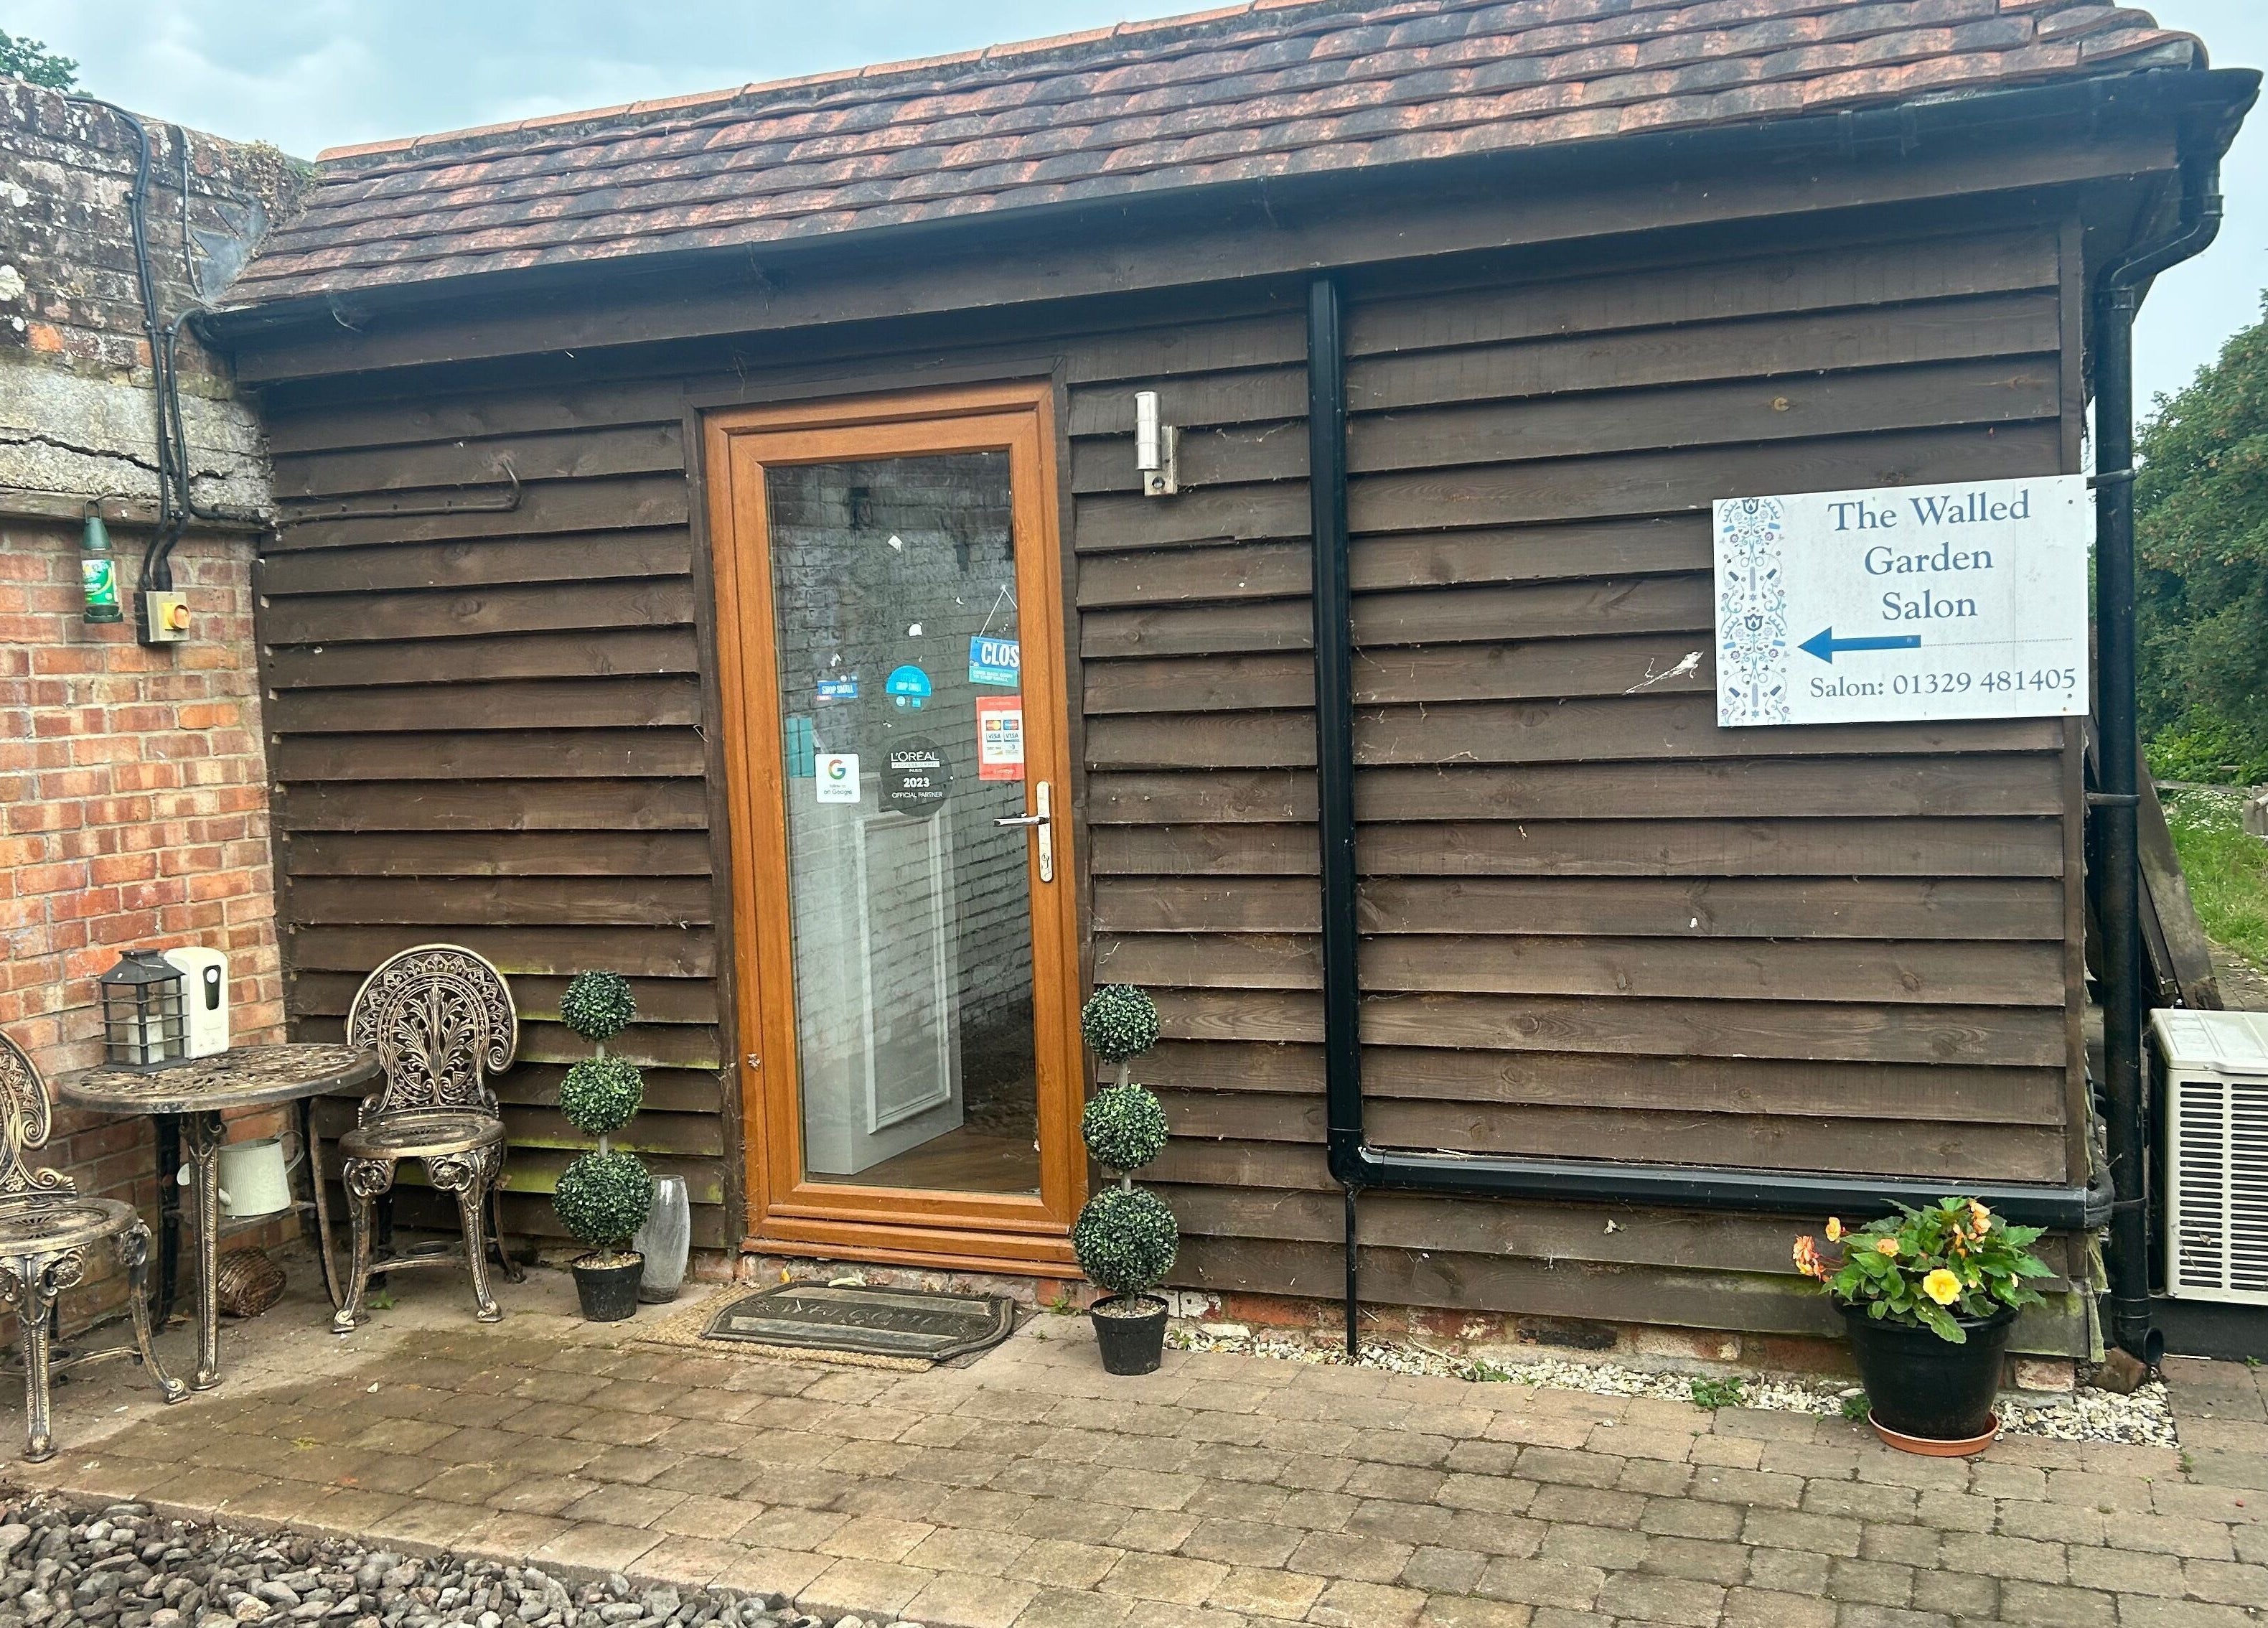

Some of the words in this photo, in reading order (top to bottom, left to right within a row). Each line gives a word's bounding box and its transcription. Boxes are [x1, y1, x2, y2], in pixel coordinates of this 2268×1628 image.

[1827, 502, 1898, 531] The
[1909, 489, 2030, 526] Walled
[1865, 542, 1994, 576] Garden
[1882, 589, 1978, 621] Salon
[822, 686, 836, 695] SHOP
[836, 684, 855, 694] SMALL
[1810, 676, 1884, 698] Salon:
[1893, 673, 1971, 696] 01329
[1980, 668, 2076, 693] 481405
[890, 751, 939, 762] L'ORÉAL
[903, 777, 930, 788] 2023
